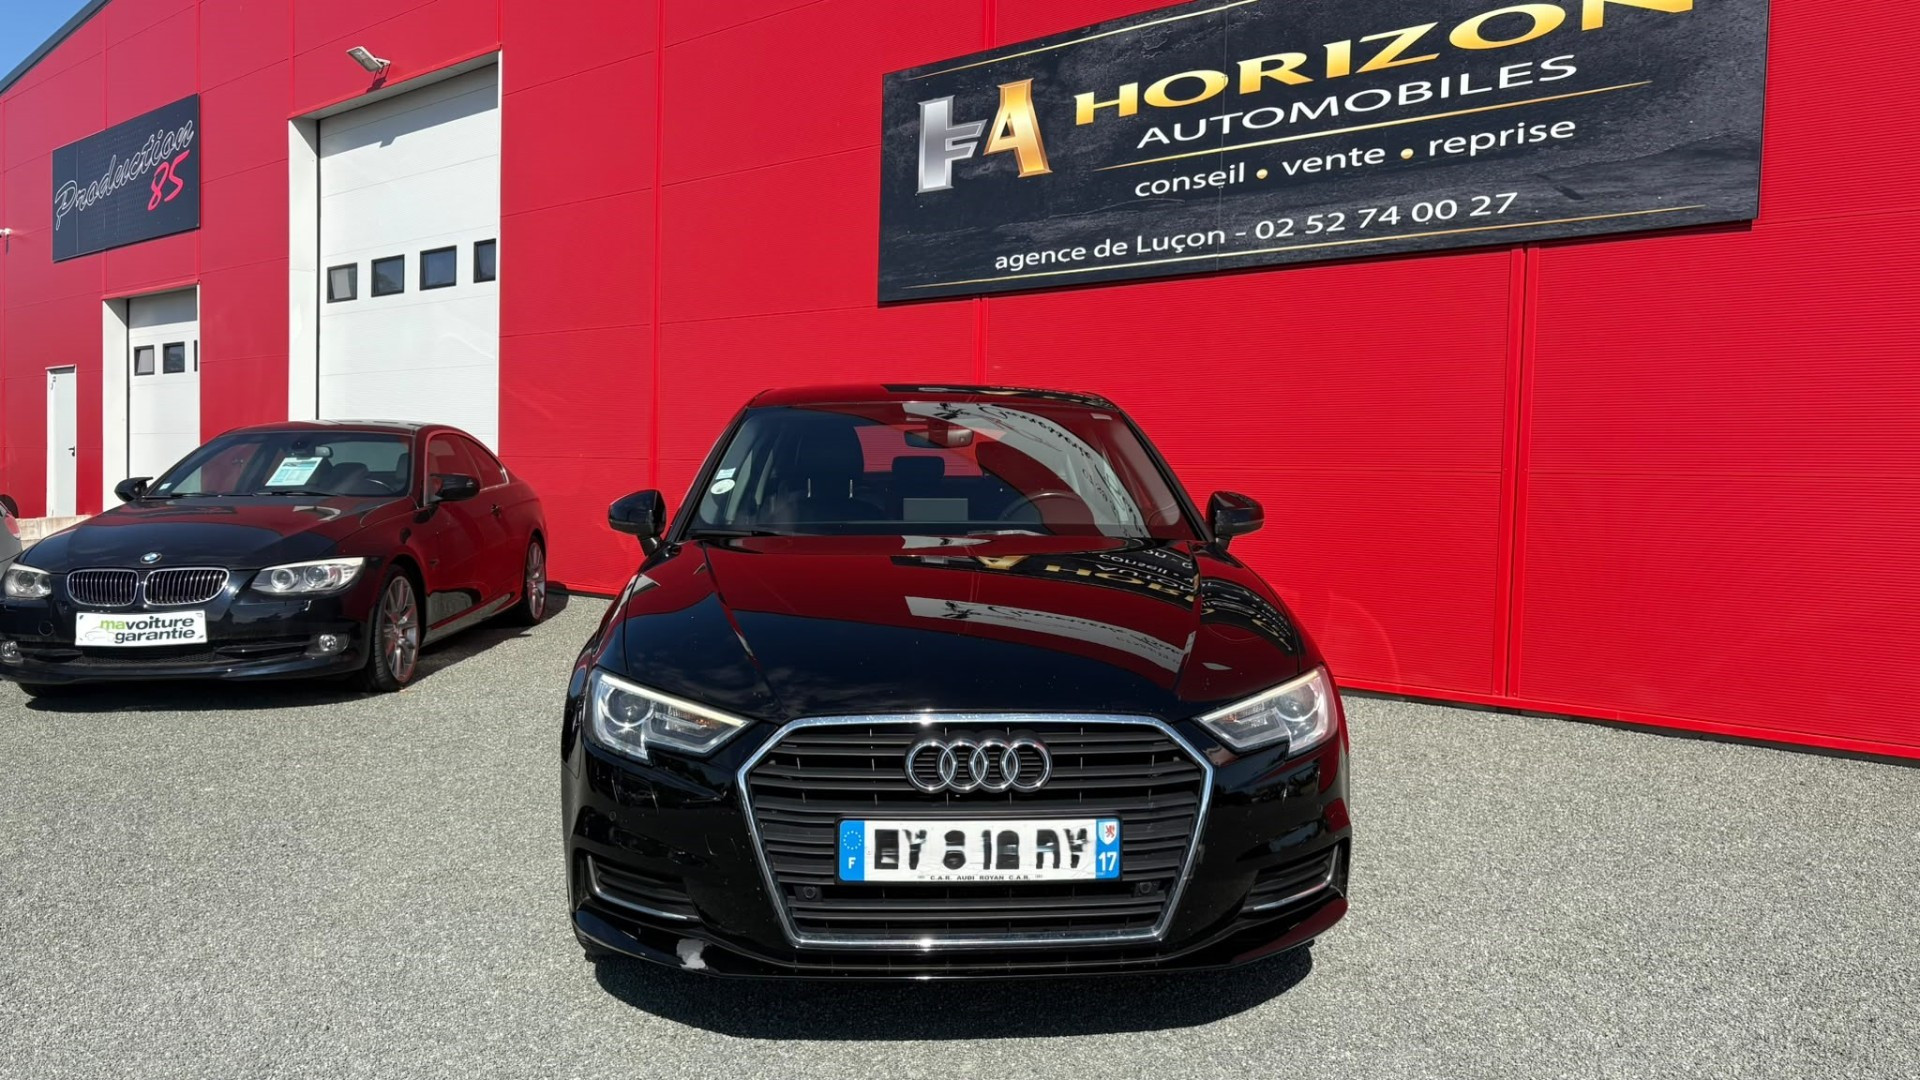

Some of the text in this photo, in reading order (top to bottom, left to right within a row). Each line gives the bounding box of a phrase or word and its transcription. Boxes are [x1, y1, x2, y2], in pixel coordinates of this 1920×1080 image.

[1137, 54, 1577, 149] AUTOMOBILES
[55, 120, 195, 231] Production
[147, 150, 190, 211] 85
[1135, 120, 1576, 197] conseil vente reprise
[995, 246, 1087, 272] agence
[1093, 239, 1128, 258] de
[1137, 229, 1225, 254] Luçon
[1255, 218, 1294, 240] 02
[1305, 212, 1345, 234] 52
[1358, 206, 1401, 229] 74
[1411, 200, 1458, 223] 00
[1469, 192, 1518, 217] 27
[100, 615, 194, 631] mavoiture
[115, 627, 195, 645] garantie
[848, 857, 856, 869] F
[1099, 851, 1118, 871] 17
